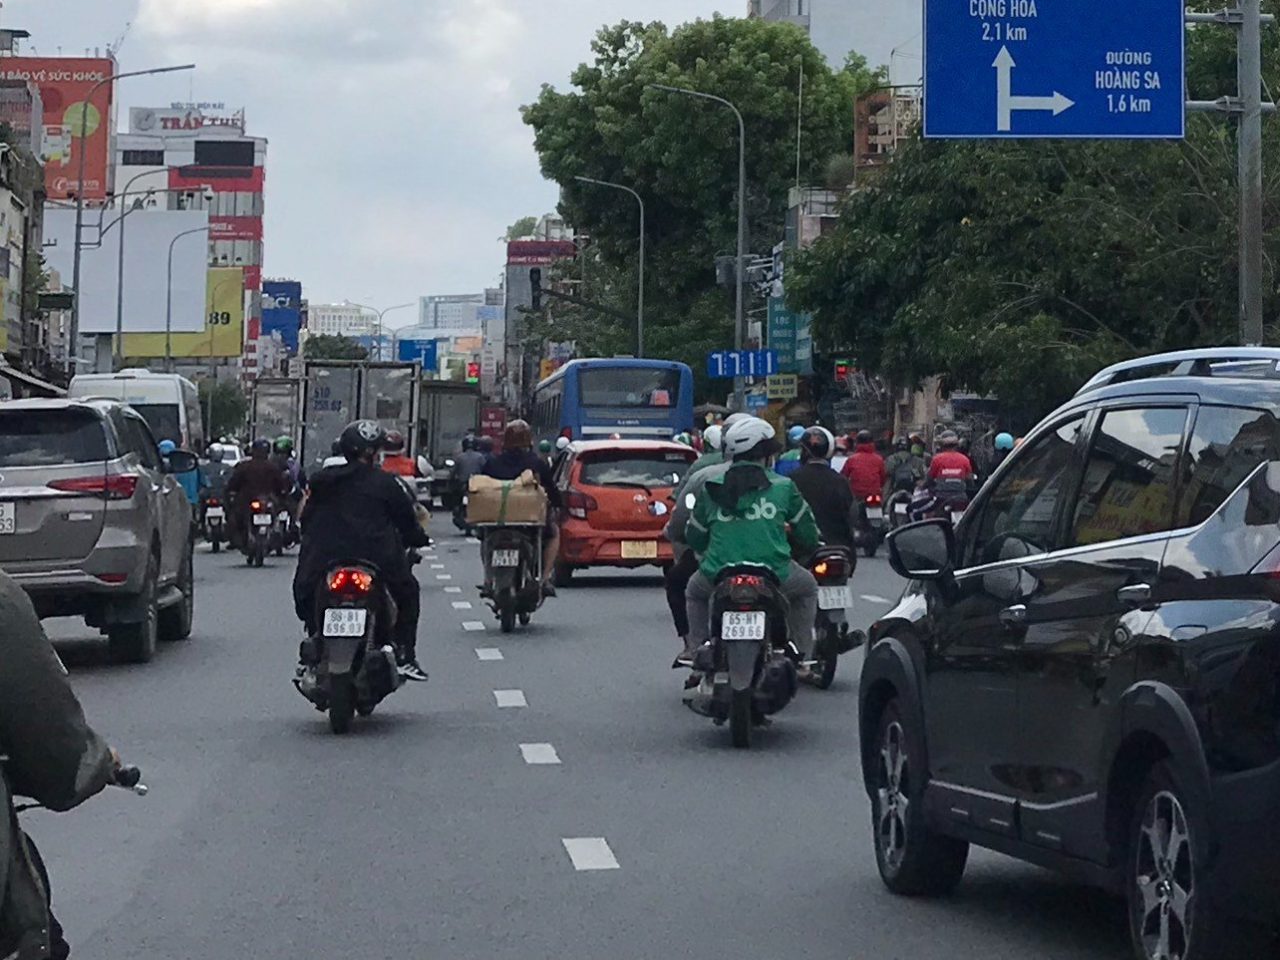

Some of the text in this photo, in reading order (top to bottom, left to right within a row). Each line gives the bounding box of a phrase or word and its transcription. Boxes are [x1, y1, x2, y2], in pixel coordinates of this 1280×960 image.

[982, 23, 1027, 42] 2,1 km
[1105, 48, 1152, 66] ĐƯỜNG
[1095, 66, 1161, 90] HOÀNG SA
[1107, 94, 1151, 114] 1,6 km
